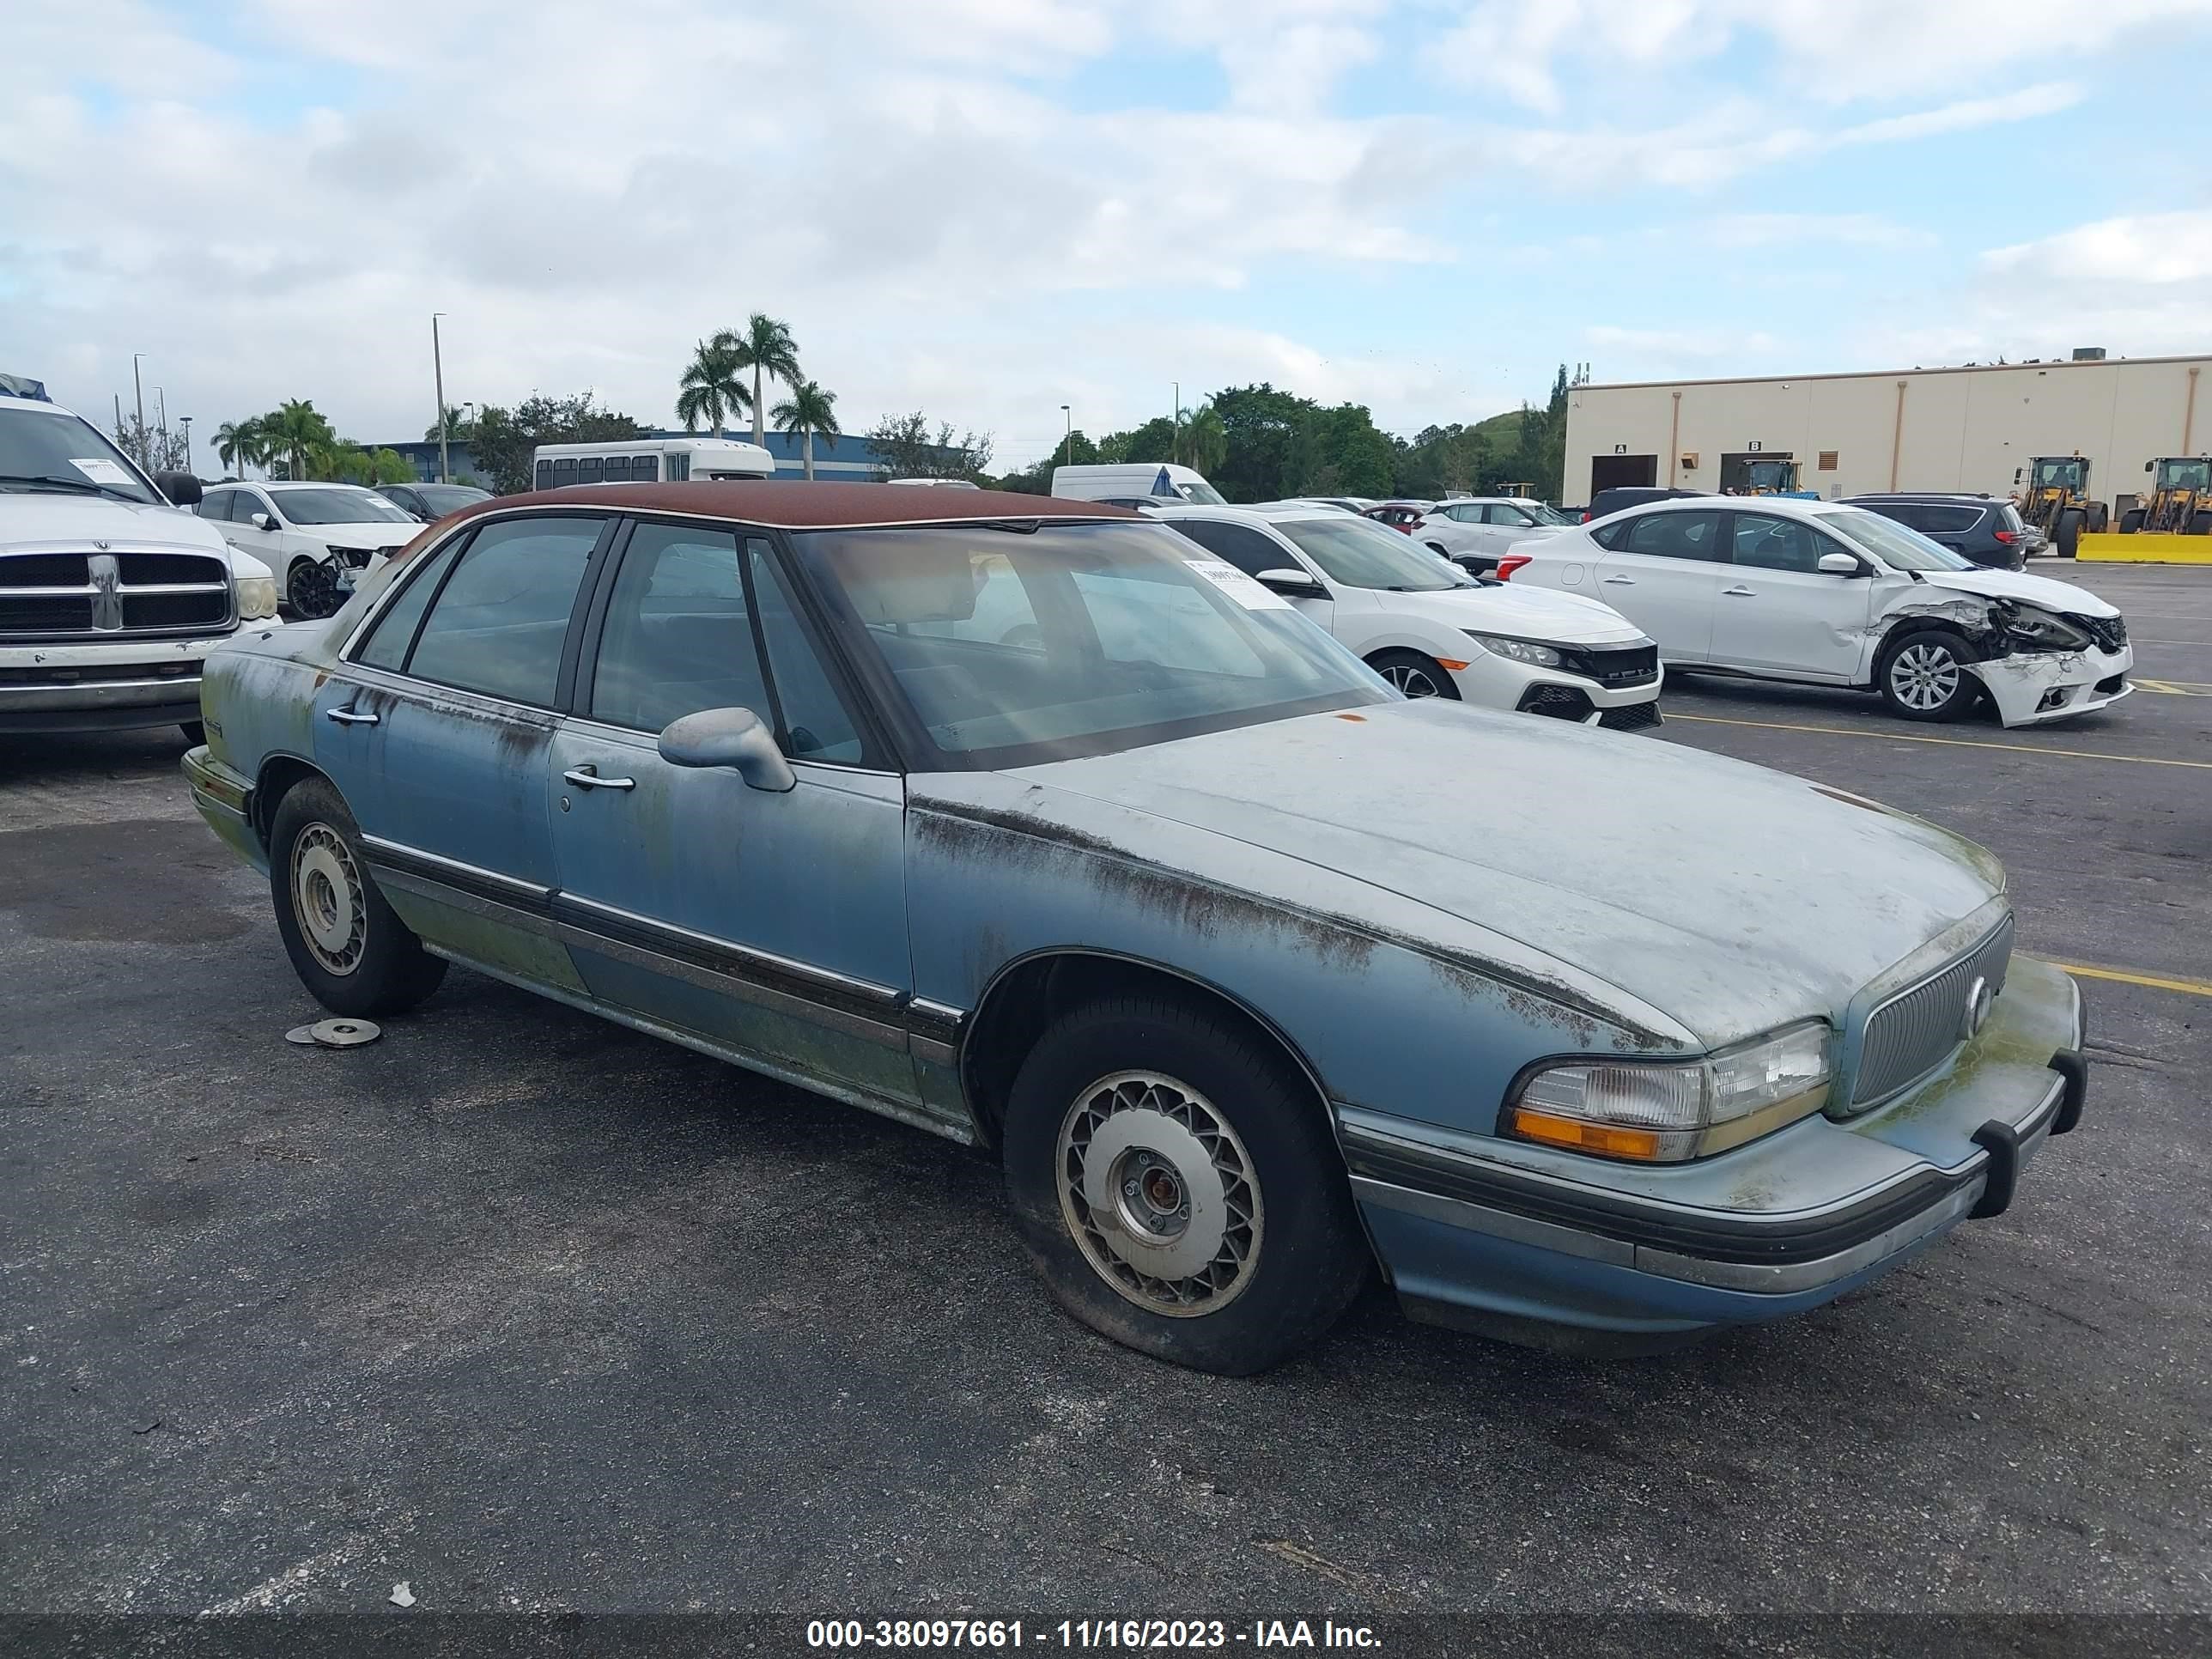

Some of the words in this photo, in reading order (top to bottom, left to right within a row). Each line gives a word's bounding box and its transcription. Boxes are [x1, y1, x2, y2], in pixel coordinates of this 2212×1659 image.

[1617, 445, 1625, 454] A
[1751, 441, 1759, 450] B
[1508, 487, 1514, 497] 5
